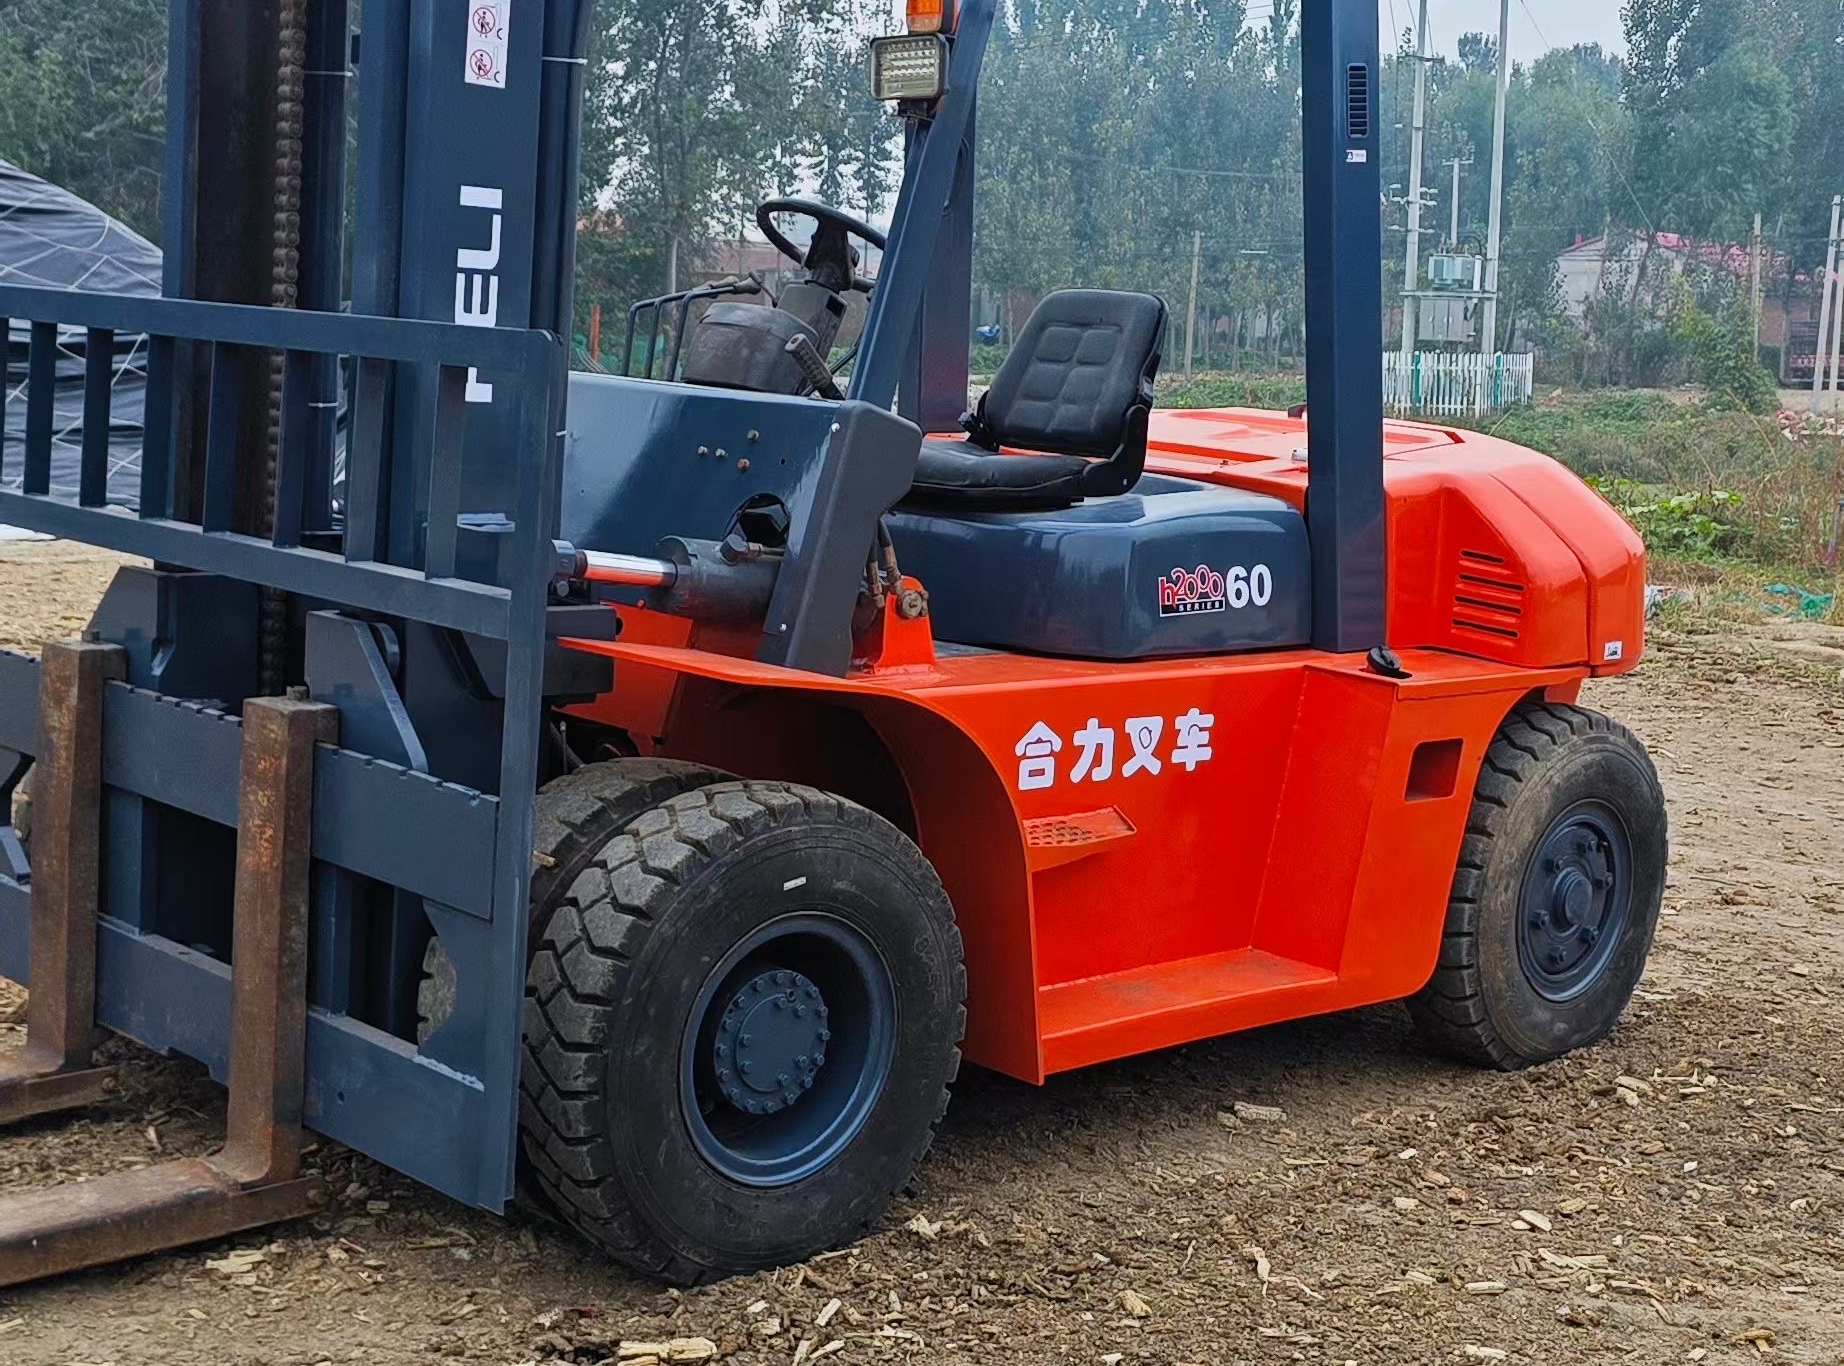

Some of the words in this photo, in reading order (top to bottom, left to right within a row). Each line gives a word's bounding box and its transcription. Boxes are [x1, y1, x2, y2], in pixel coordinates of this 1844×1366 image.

[1178, 600, 1221, 612] SERIES
[1226, 563, 1272, 609] 60
[1015, 708, 1214, 790] 合力叉车
